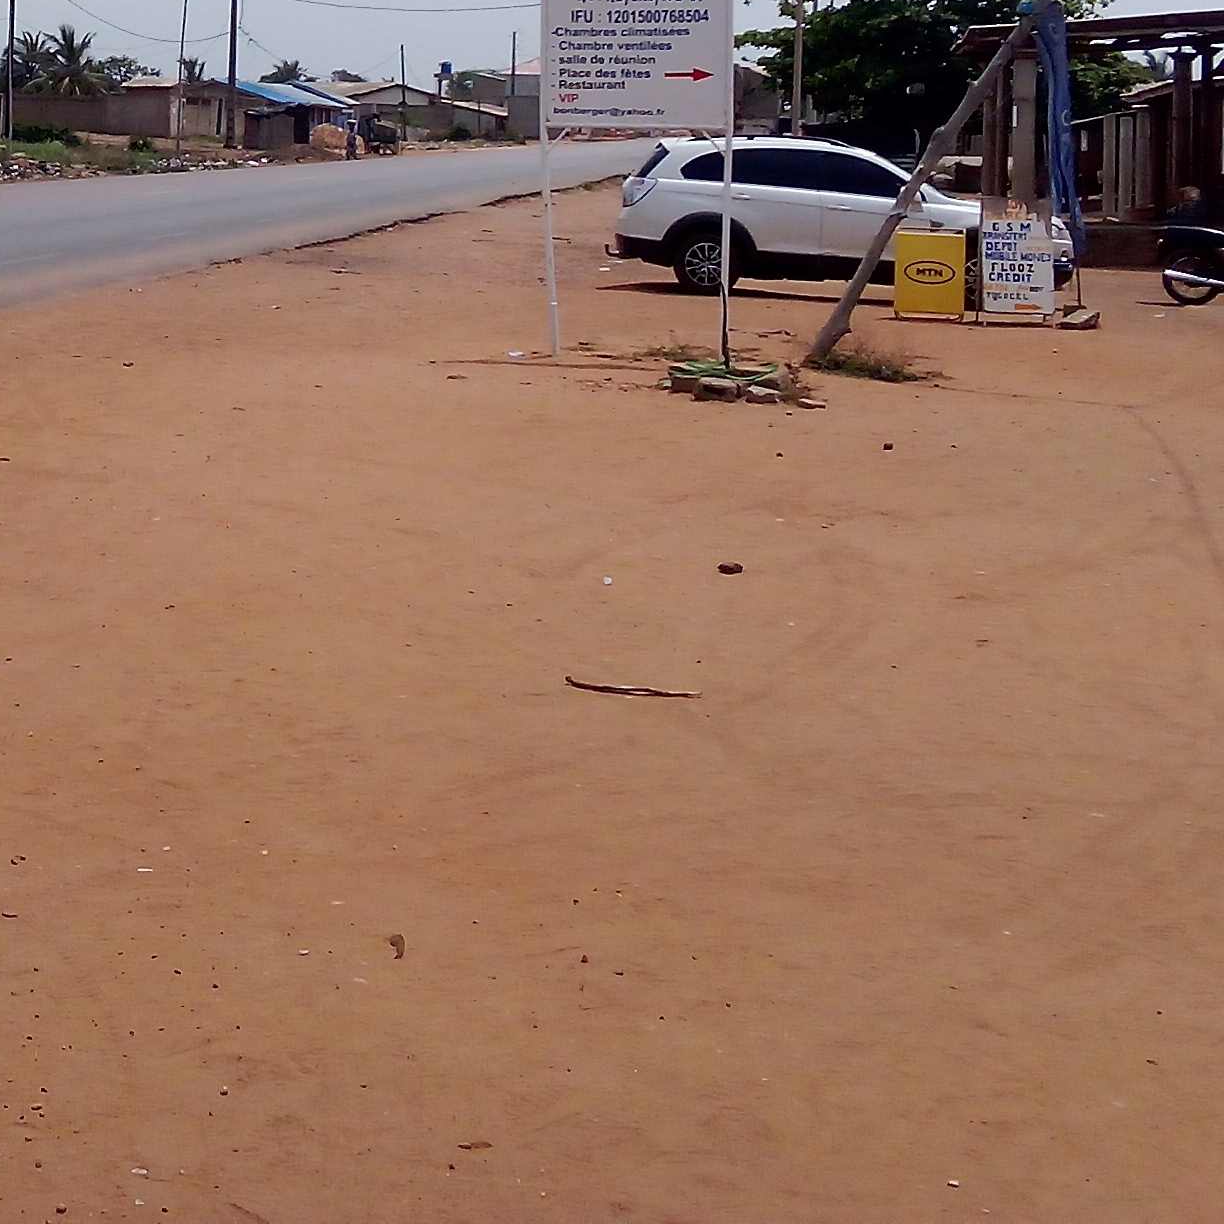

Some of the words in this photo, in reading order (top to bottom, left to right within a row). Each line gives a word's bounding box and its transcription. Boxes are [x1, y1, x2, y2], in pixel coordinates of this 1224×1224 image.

[571, 10, 594, 23] IFU
[606, 9, 710, 24] 1201500768504
[558, 40, 614, 51] Chambre
[558, 56, 587, 65] salle
[590, 55, 605, 65] de
[608, 55, 656, 65] réunion
[559, 68, 592, 78] Place
[594, 68, 617, 78] des
[558, 80, 626, 90] Restaurant
[559, 93, 579, 103] VIP
[916, 267, 944, 277] MTN
[988, 272, 1032, 283] CREDIT
